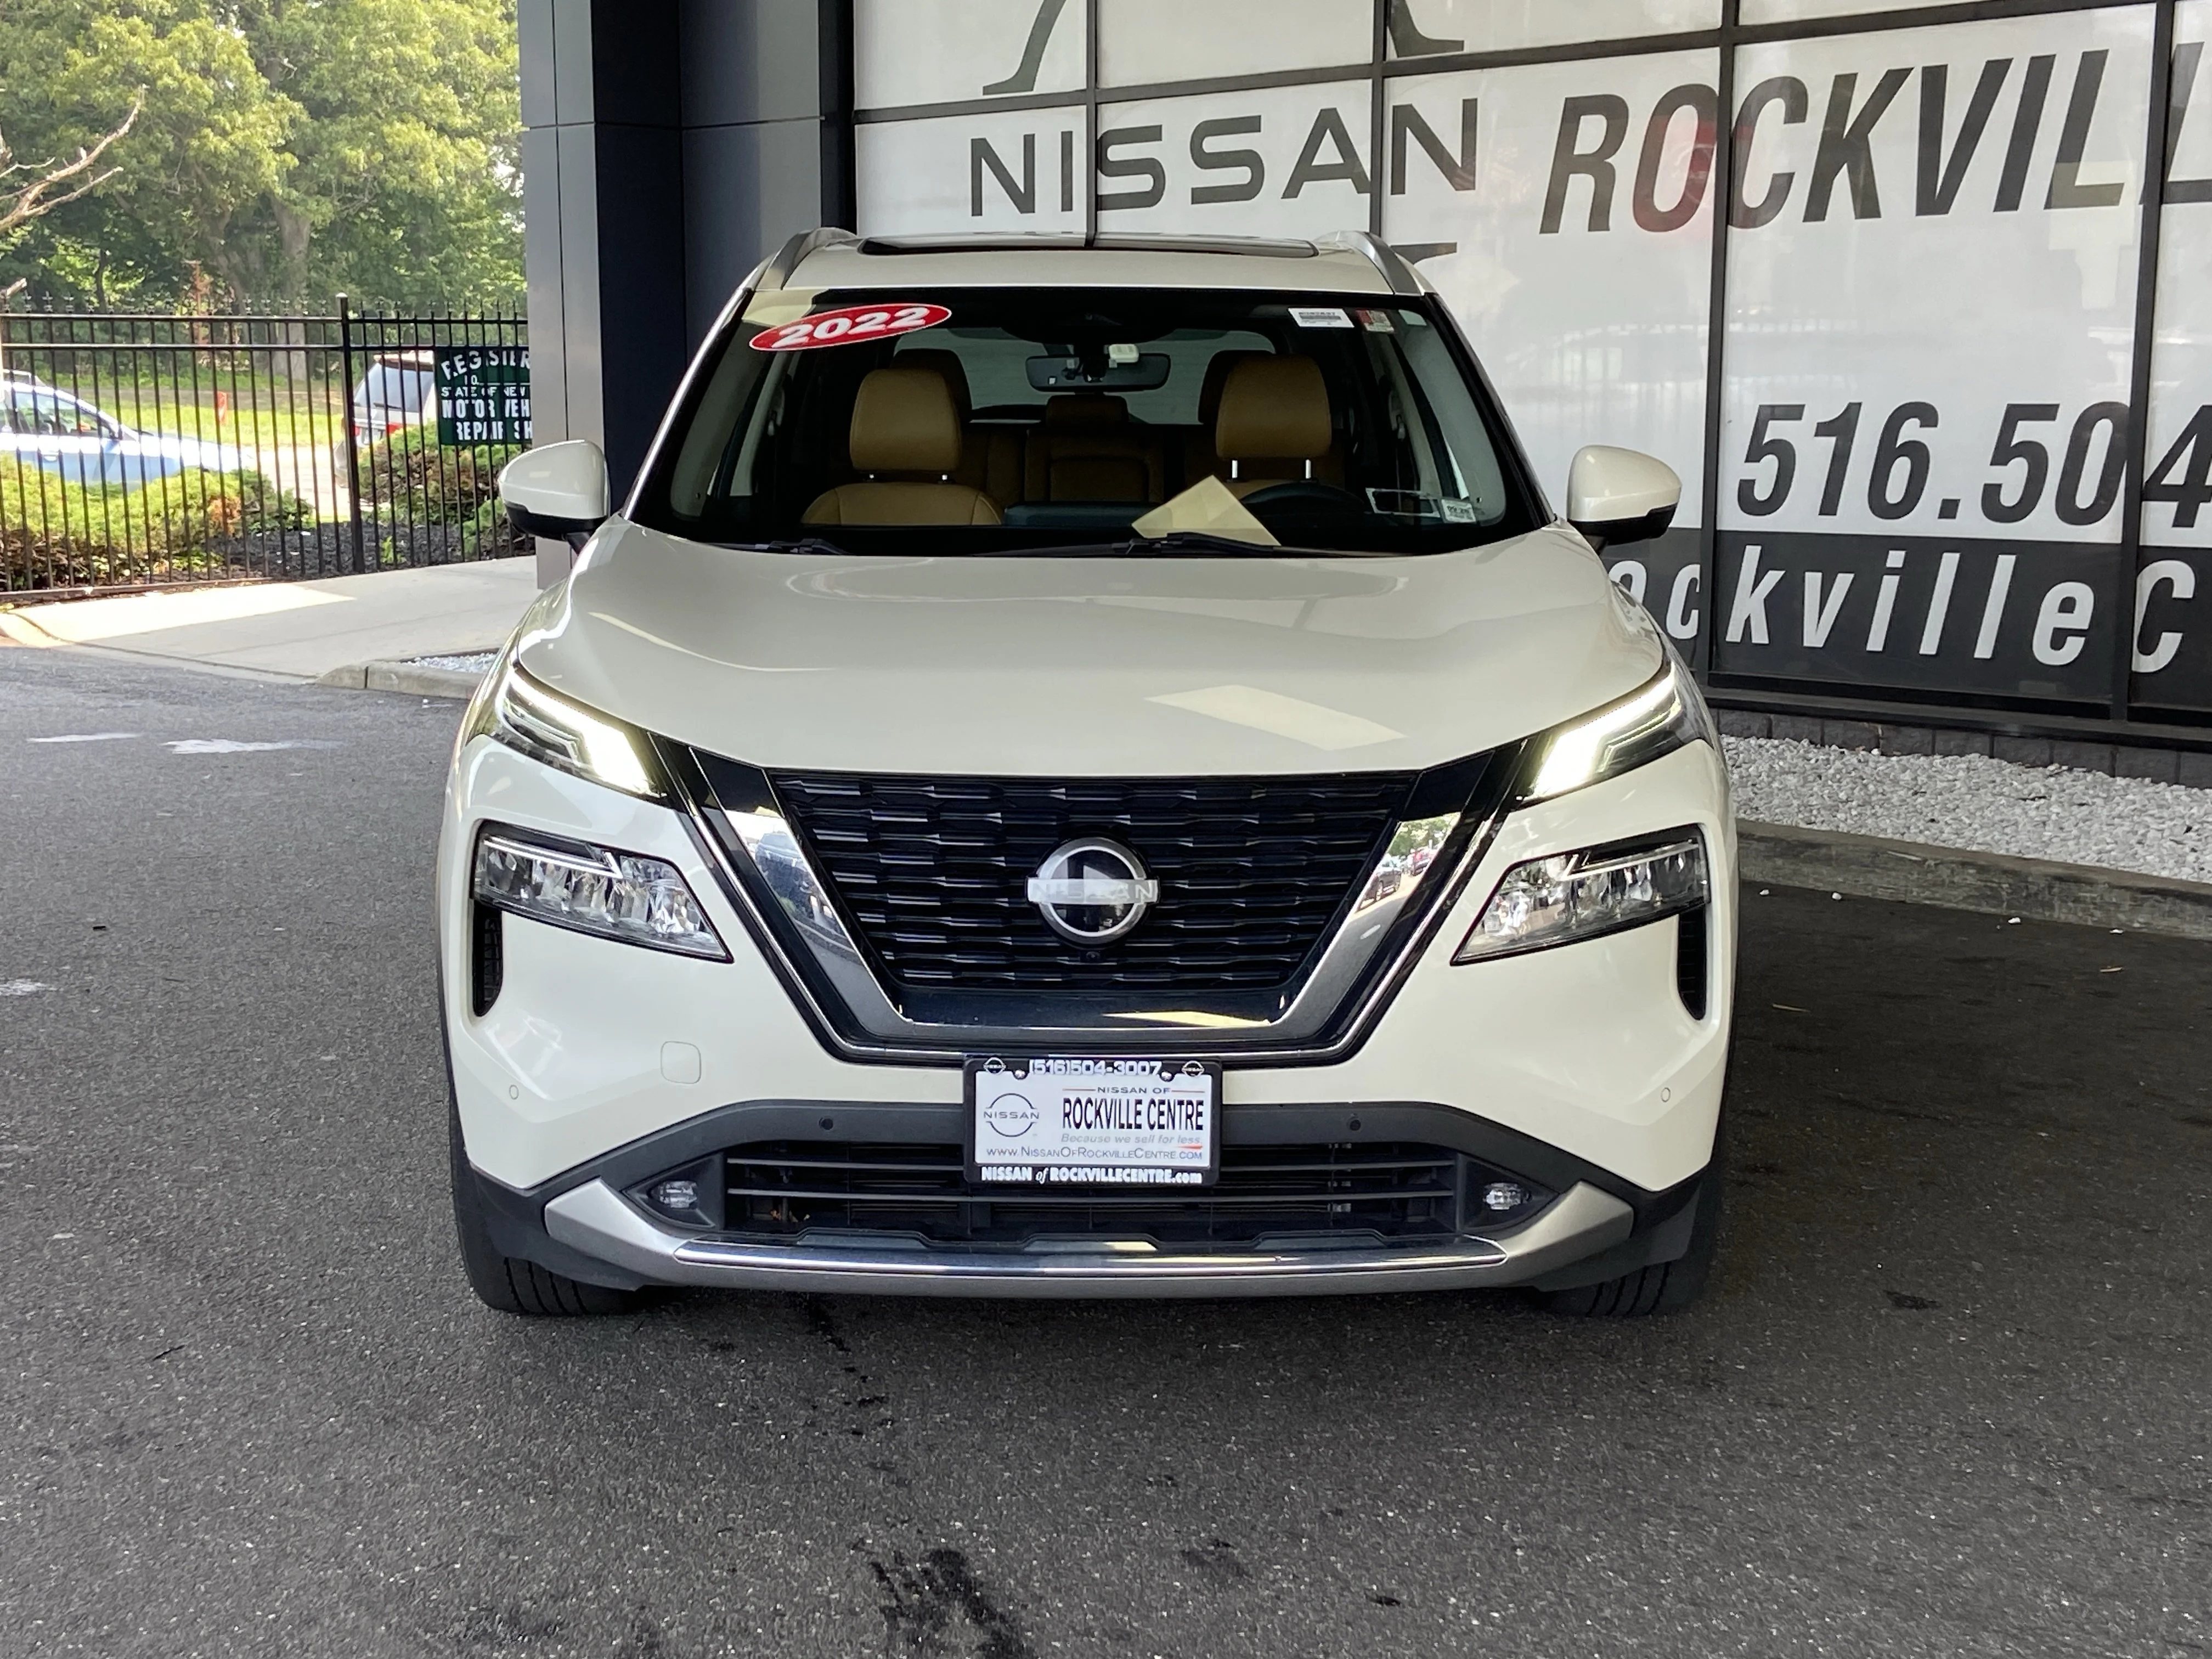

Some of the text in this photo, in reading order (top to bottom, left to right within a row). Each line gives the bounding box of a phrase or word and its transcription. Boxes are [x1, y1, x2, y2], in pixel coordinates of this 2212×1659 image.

[970, 98, 1477, 216] NISSAN
[771, 307, 930, 348] 2022
[441, 387, 477, 397] SATE
[984, 1110, 1039, 1119] NISSAN
[1062, 1097, 1204, 1131] ROCKVILLE CENTRE
[1061, 1133, 1110, 1143] Because
[1158, 1134, 1175, 1144] for
[981, 1167, 1203, 1184] NISSAN of ROCKVILLECENTRE.com
